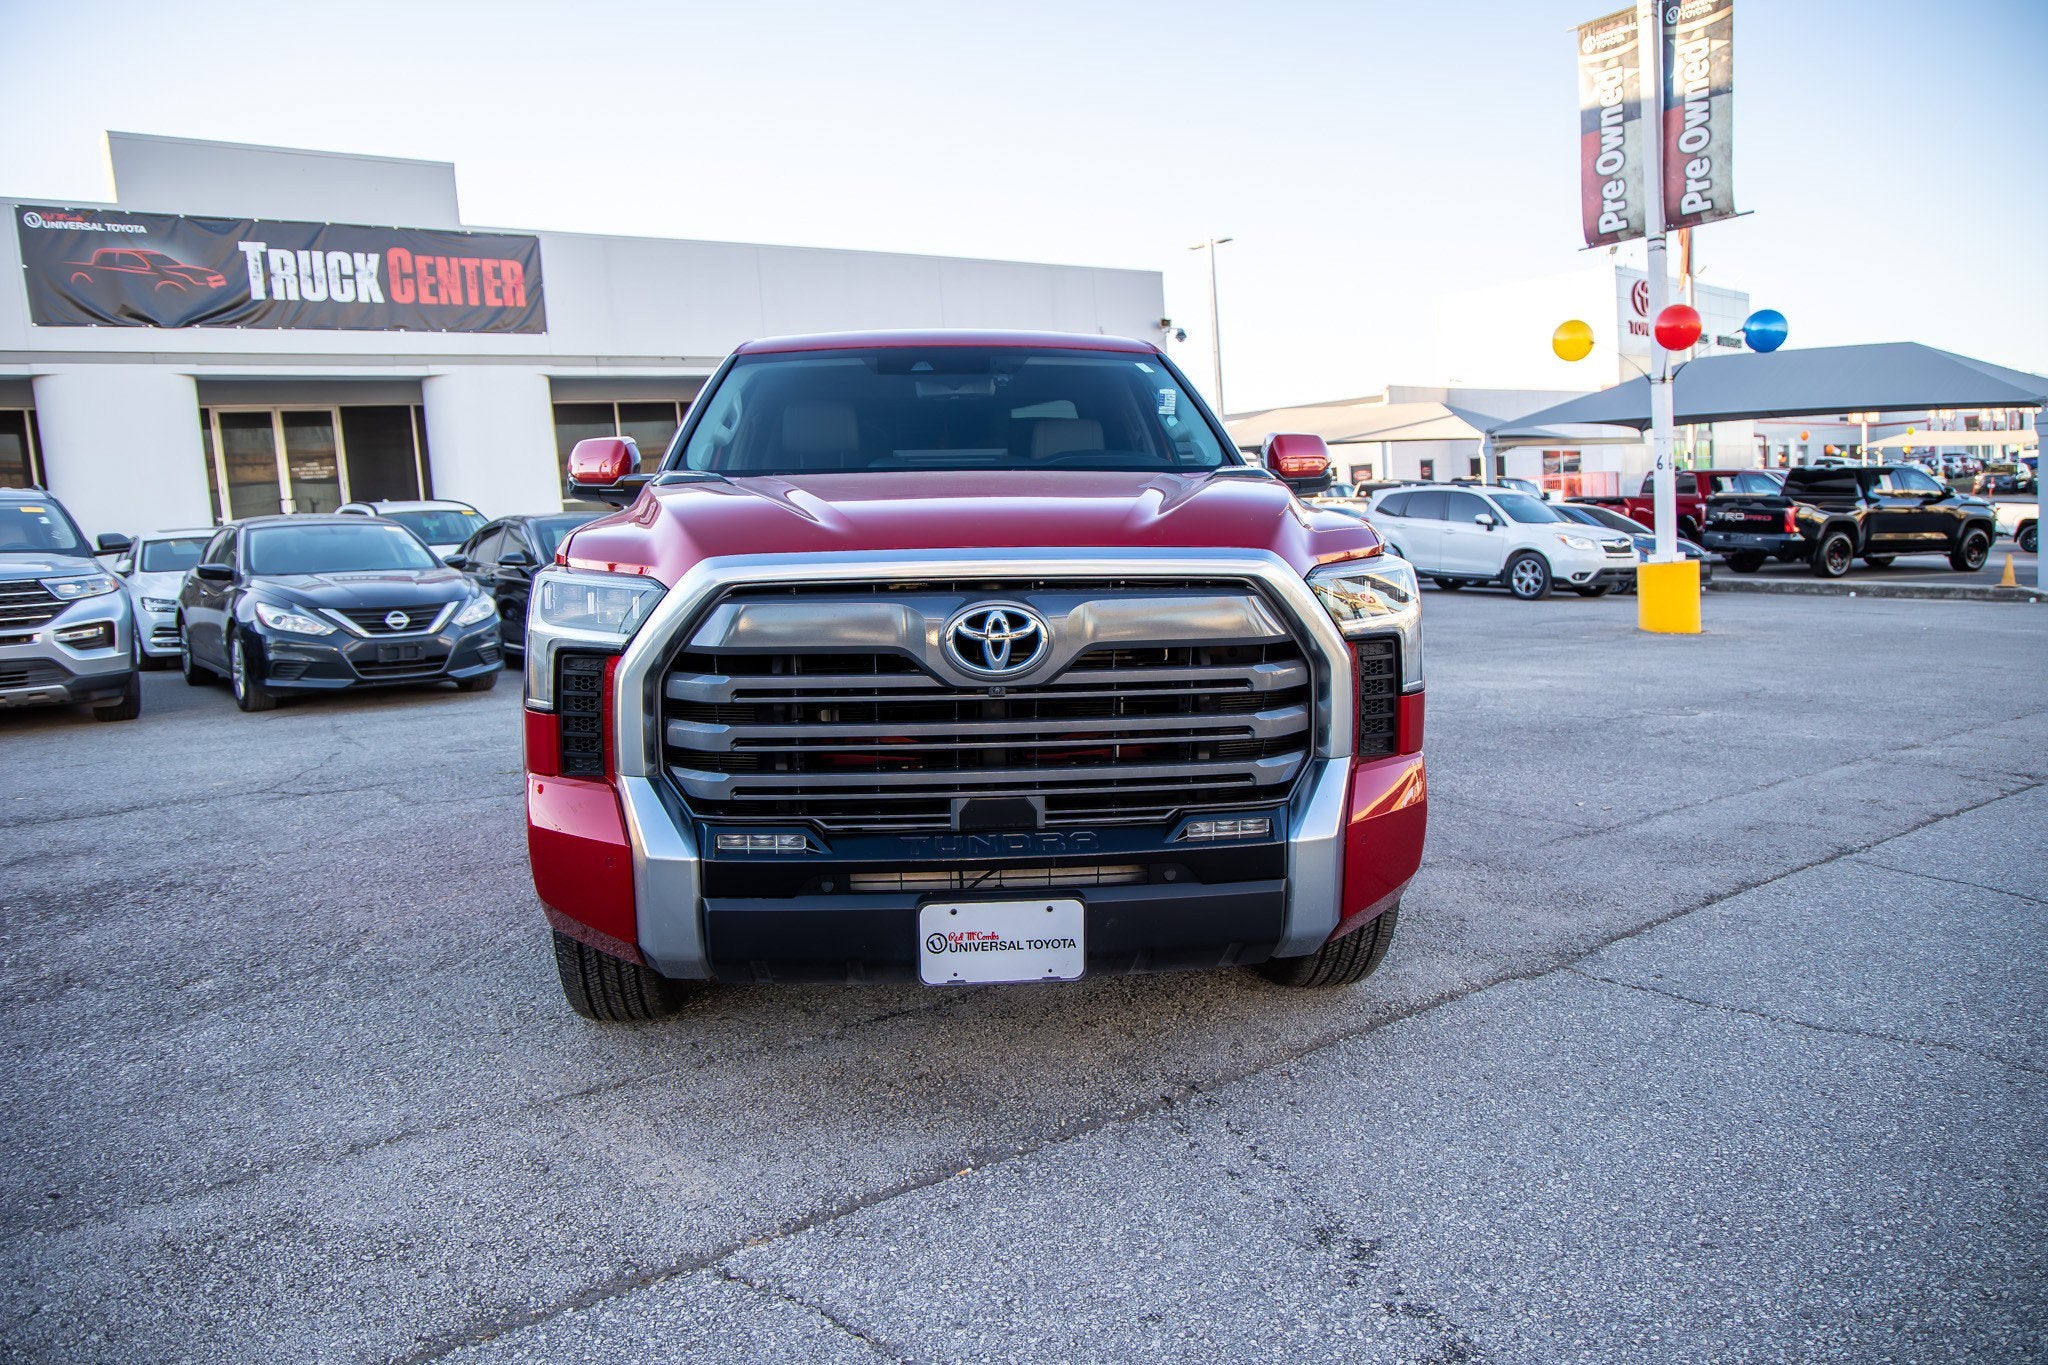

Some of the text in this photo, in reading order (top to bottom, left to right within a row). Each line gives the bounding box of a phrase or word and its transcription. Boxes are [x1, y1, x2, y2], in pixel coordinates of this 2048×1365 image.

[1594, 65, 1626, 176] Owned
[1678, 36, 1713, 216] Pre Owned
[1597, 178, 1628, 235] Pre
[42, 221, 106, 232] UNIVERSAL
[104, 223, 147, 234] TOYOTA
[1656, 454, 1664, 470] 6
[1717, 511, 1745, 522] TRD
[899, 831, 1100, 855] TUNDRA
[948, 931, 964, 945] Red
[948, 940, 1024, 953] UNIVERSAL
[1026, 938, 1077, 950] TOYOTA
